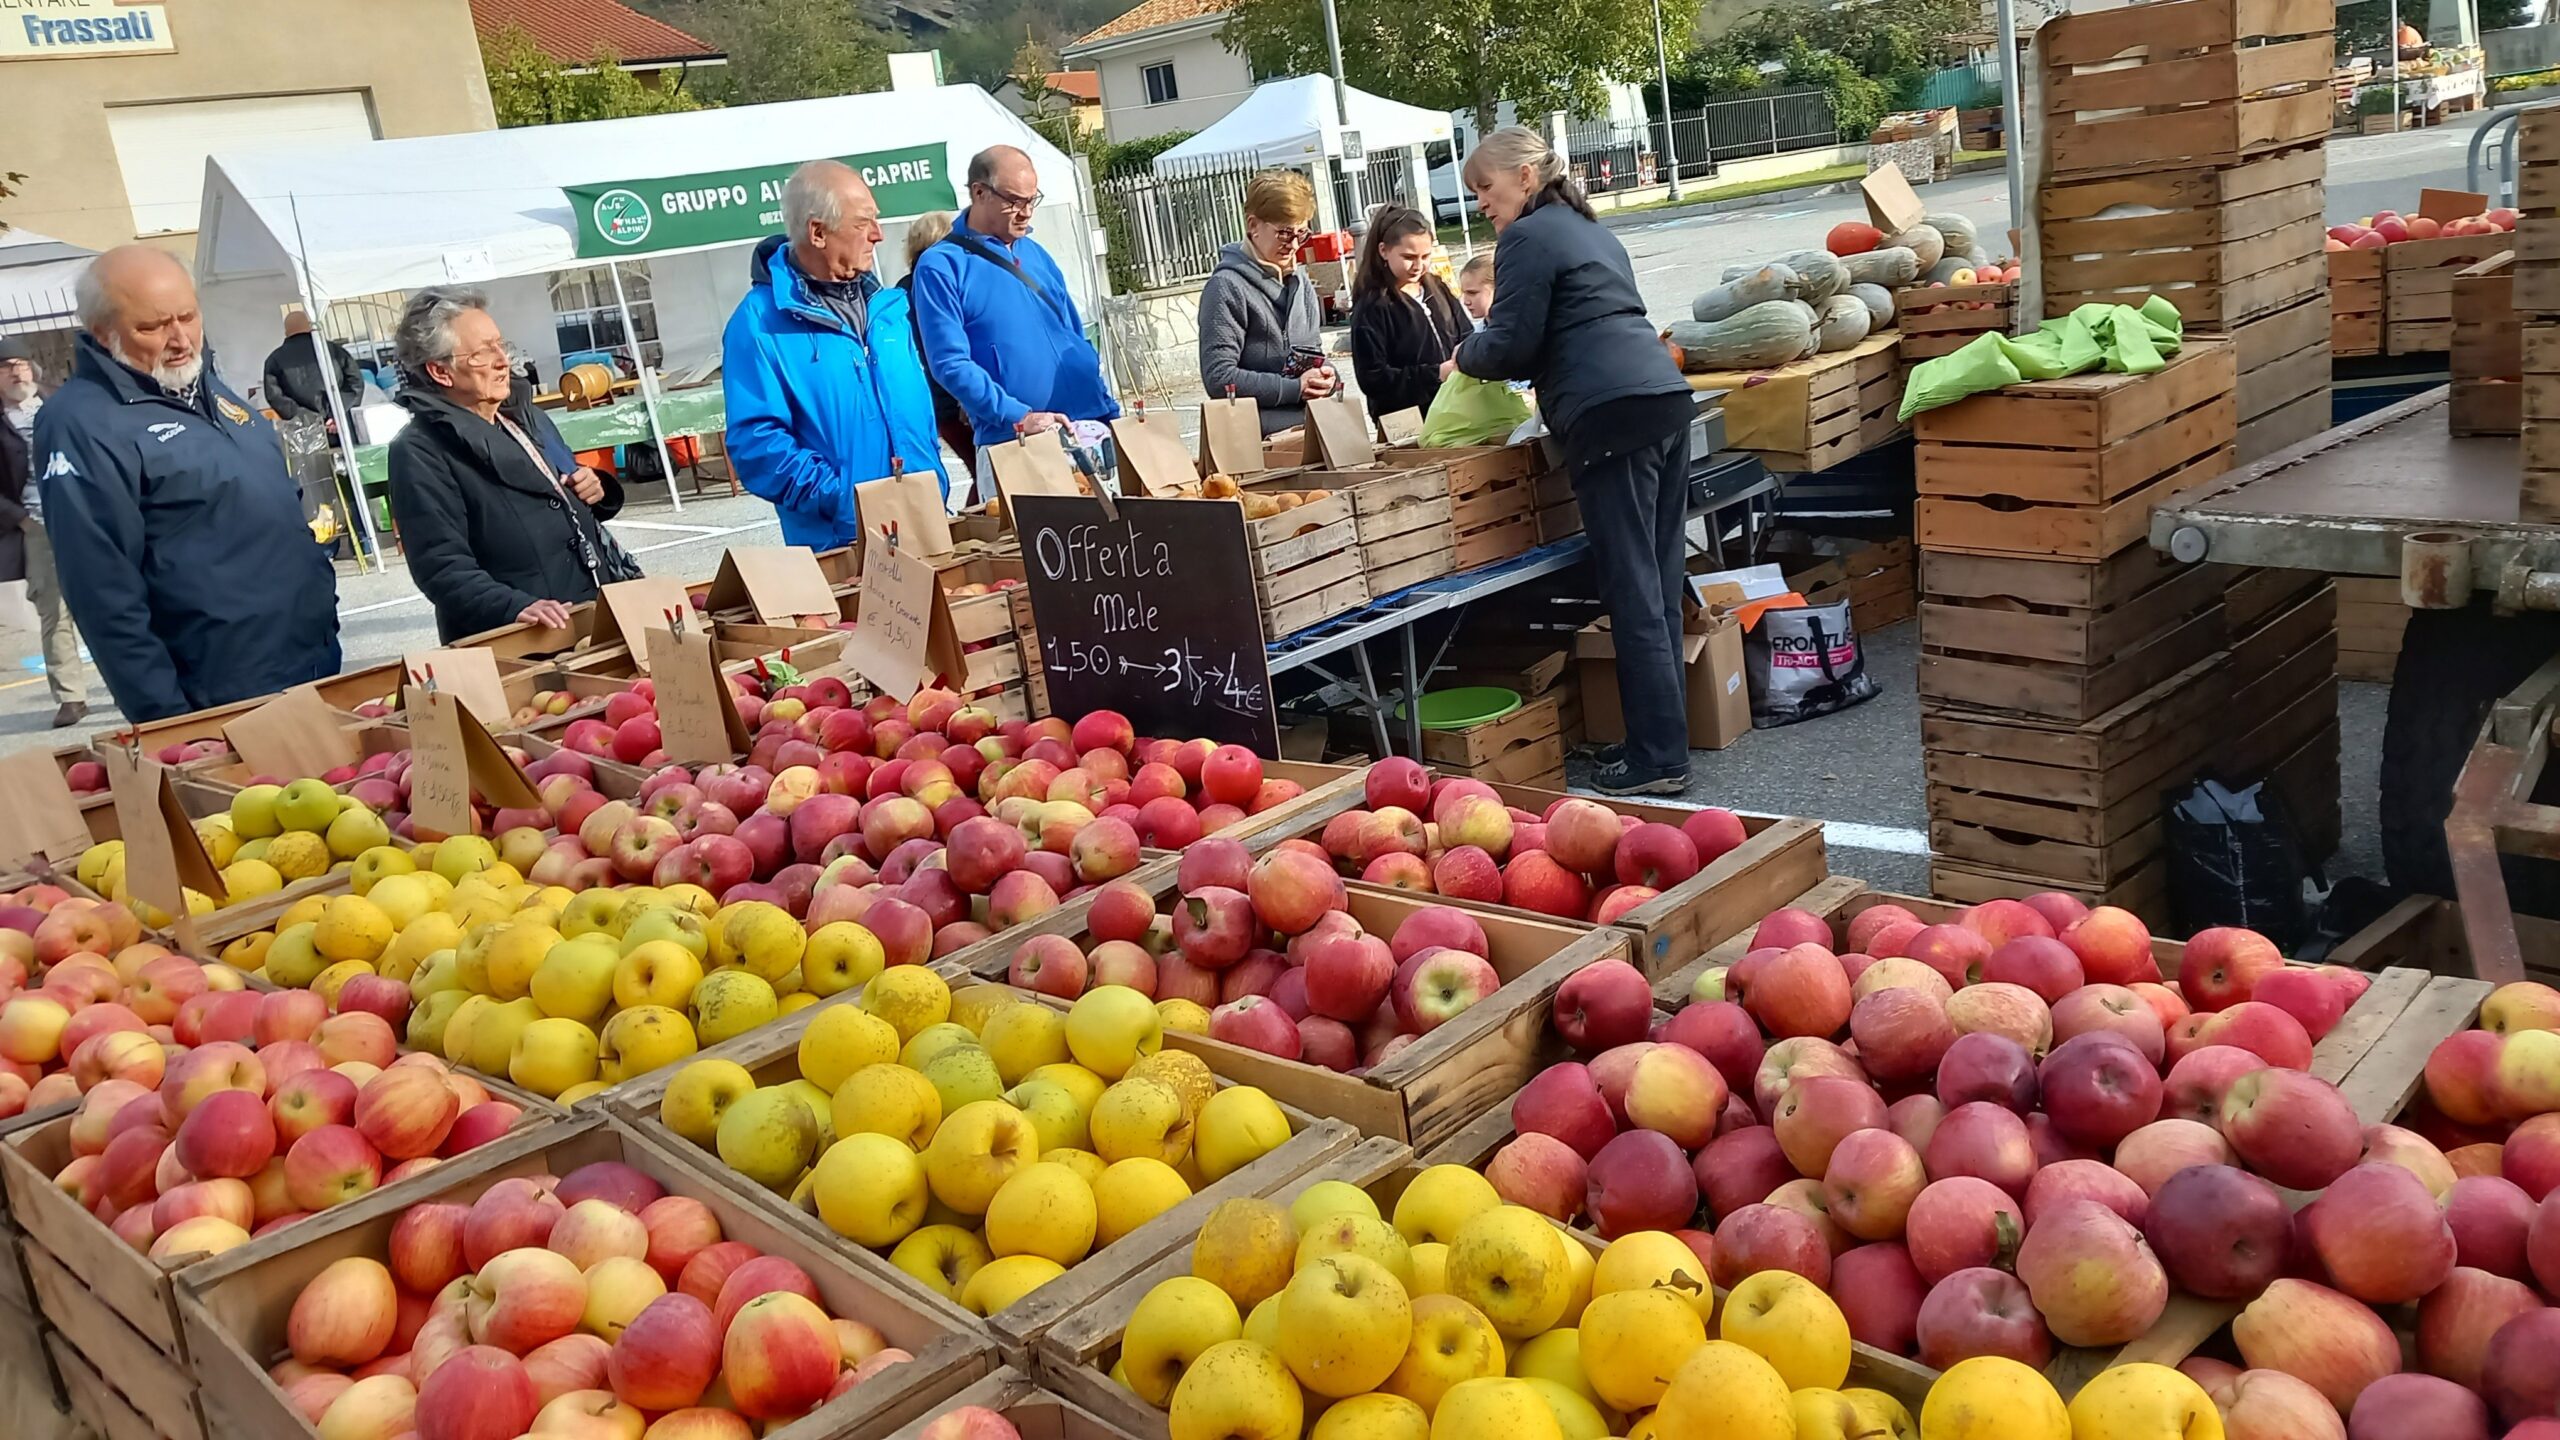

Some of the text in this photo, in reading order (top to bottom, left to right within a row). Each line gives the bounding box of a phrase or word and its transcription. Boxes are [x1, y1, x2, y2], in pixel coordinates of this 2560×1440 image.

[22, 11, 155, 46] Frassati
[661, 184, 748, 214] GRUPPO
[861, 158, 932, 188] CAPRIE
[1036, 519, 1173, 582] Offerta
[883, 619, 912, 650] 1,50
[1093, 590, 1160, 634] Mele
[1047, 635, 1112, 682] 1,50
